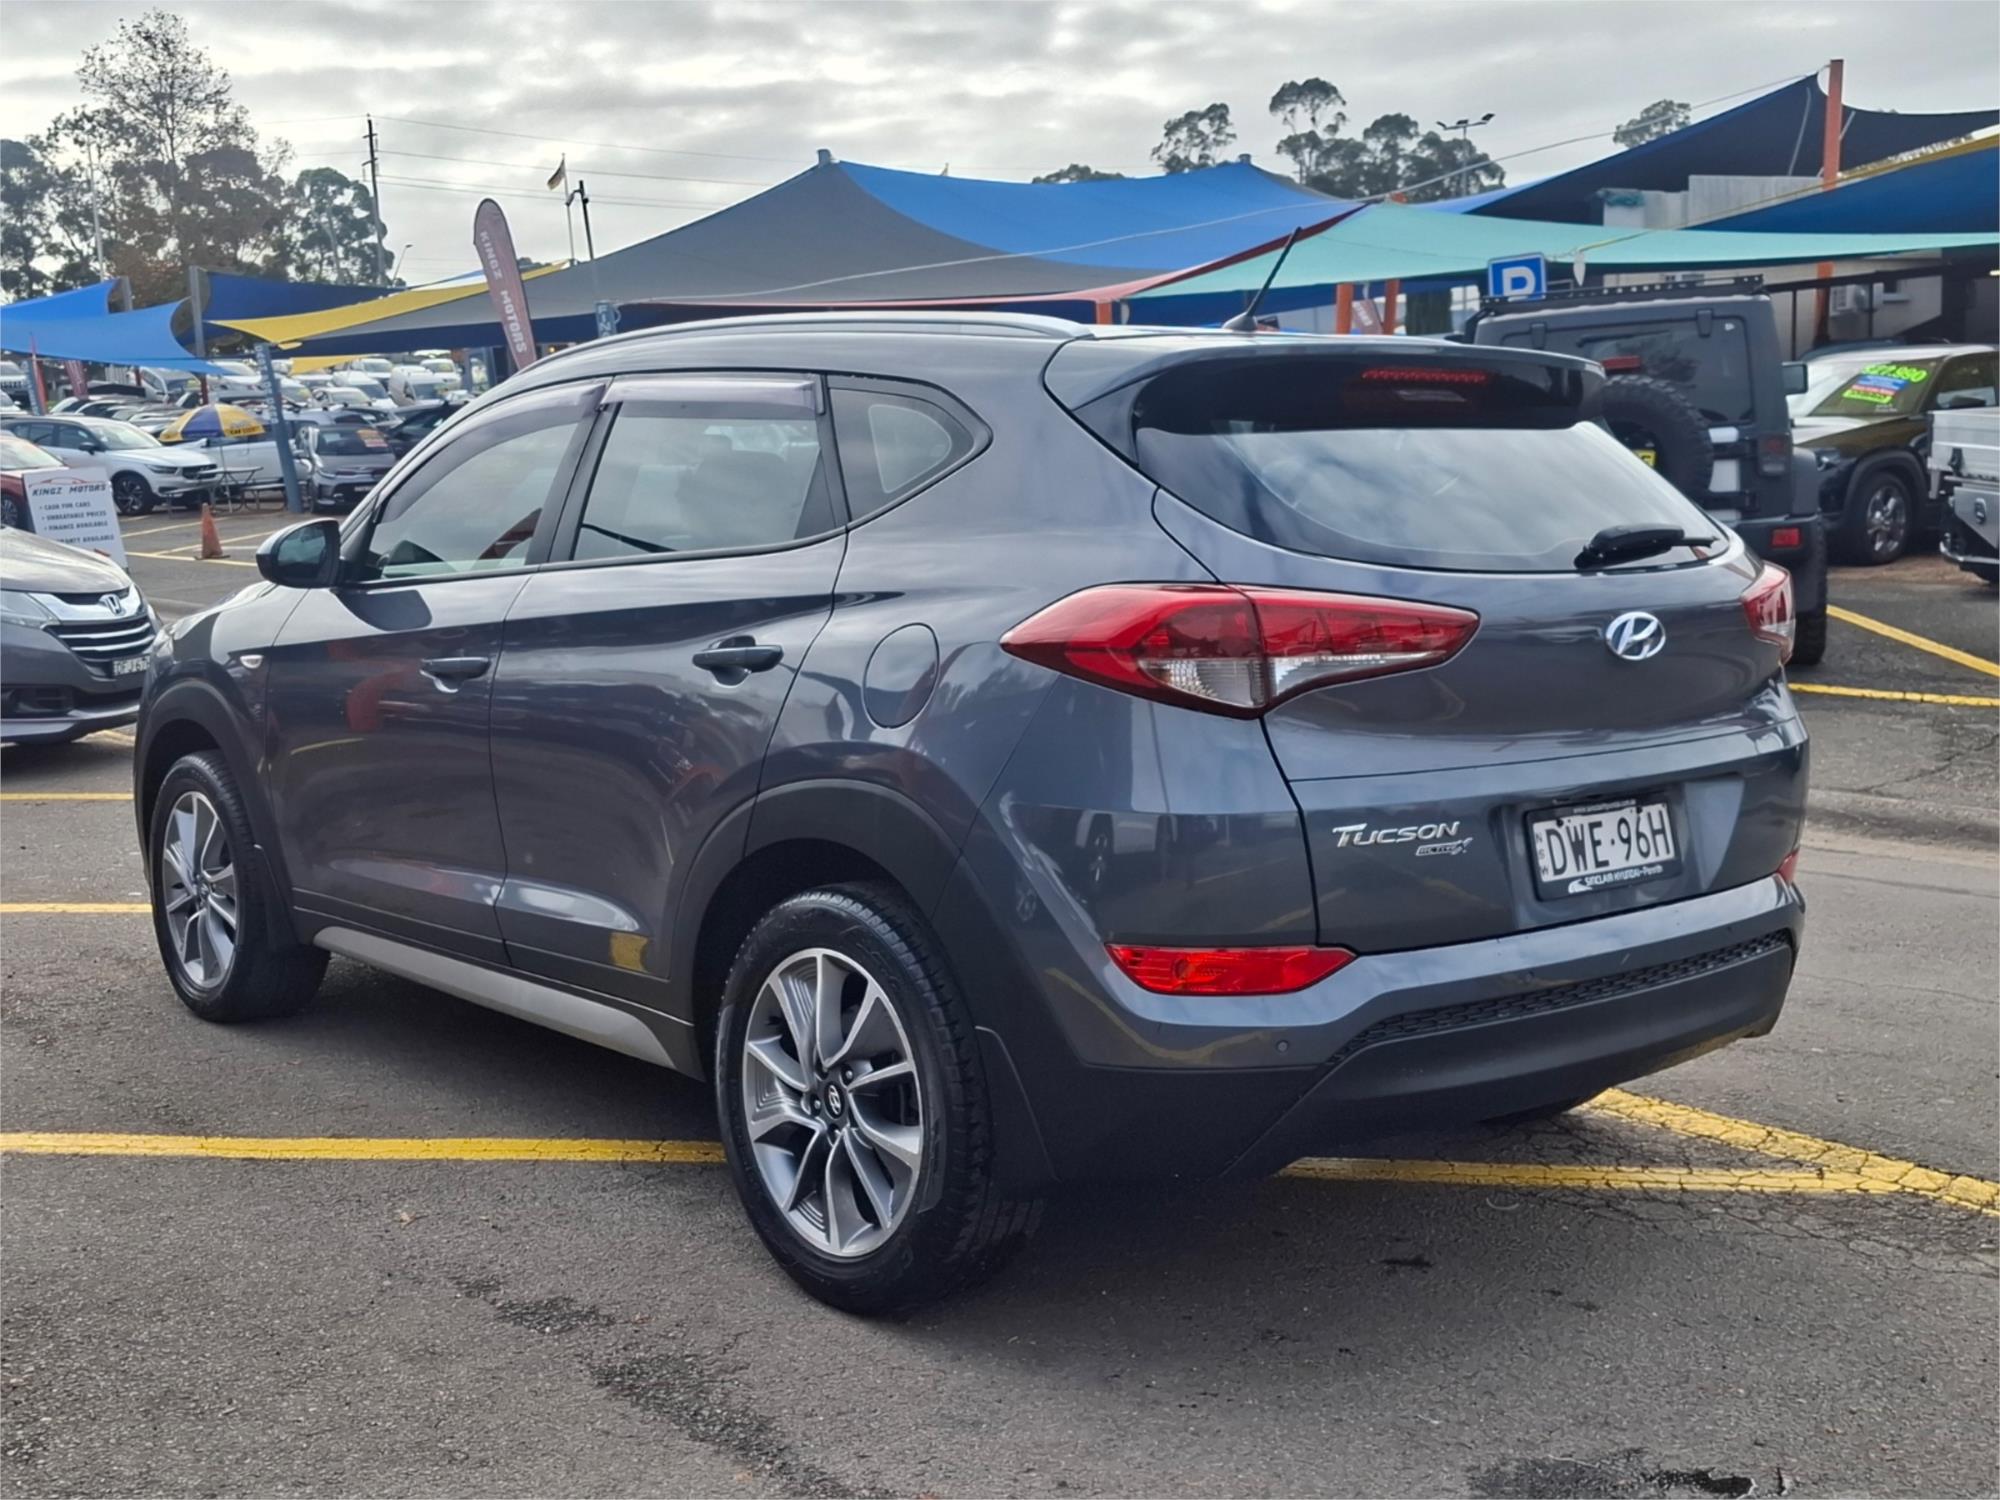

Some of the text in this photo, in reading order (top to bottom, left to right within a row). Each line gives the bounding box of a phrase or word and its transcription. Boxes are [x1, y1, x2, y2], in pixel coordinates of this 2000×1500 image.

[480, 231, 527, 353] KINGZ MOTORS
[32, 484, 107, 496] KINGZ MOTORS
[1332, 821, 1460, 848] TUCSON
